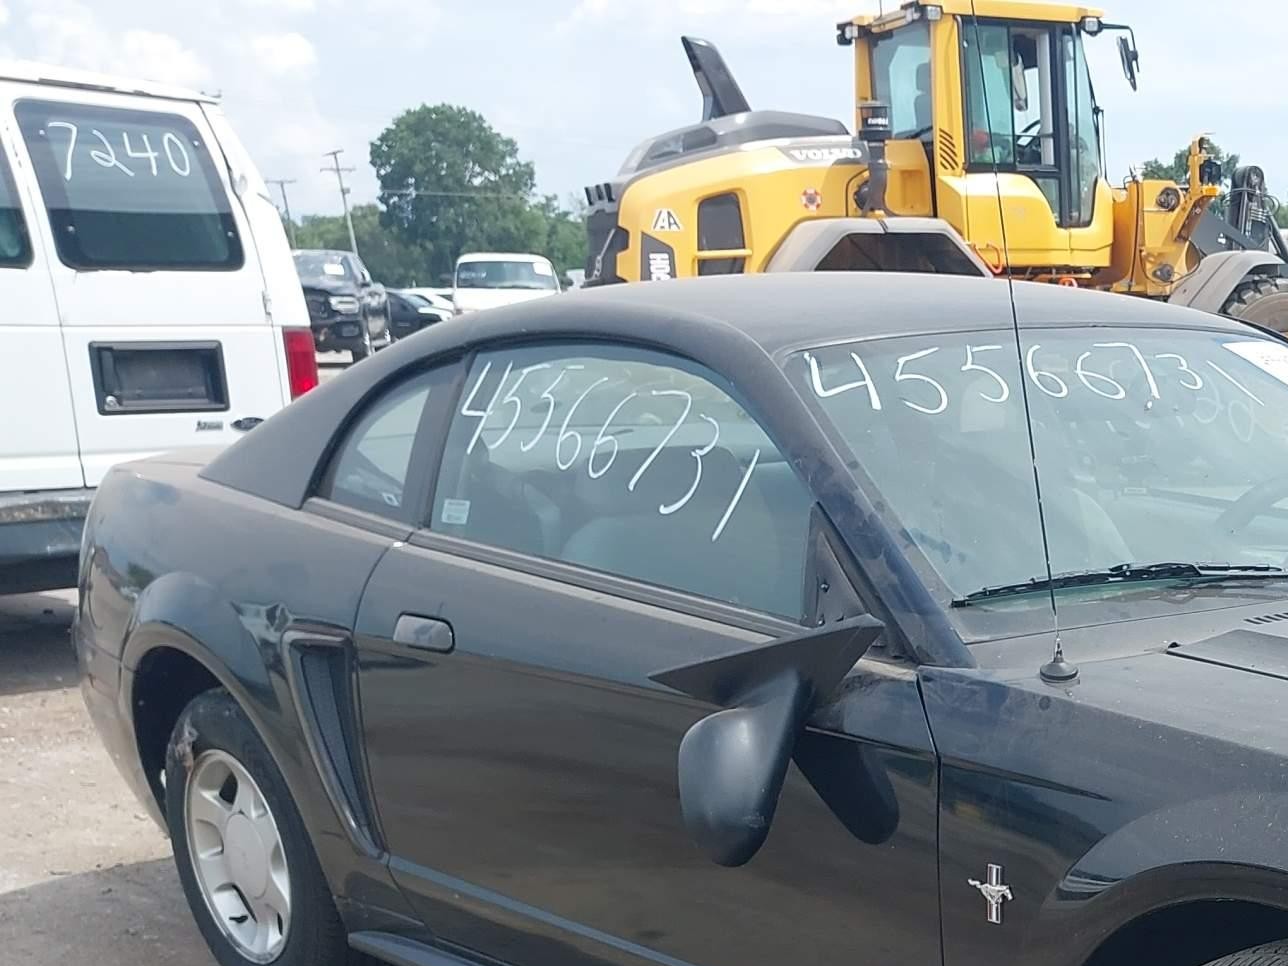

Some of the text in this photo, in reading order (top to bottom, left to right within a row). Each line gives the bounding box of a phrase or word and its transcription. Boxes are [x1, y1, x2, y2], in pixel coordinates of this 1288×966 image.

[48, 121, 190, 181] 7240
[789, 148, 862, 161] VOLVO
[803, 343, 1266, 415] 45566731
[460, 361, 761, 542] 45566731
